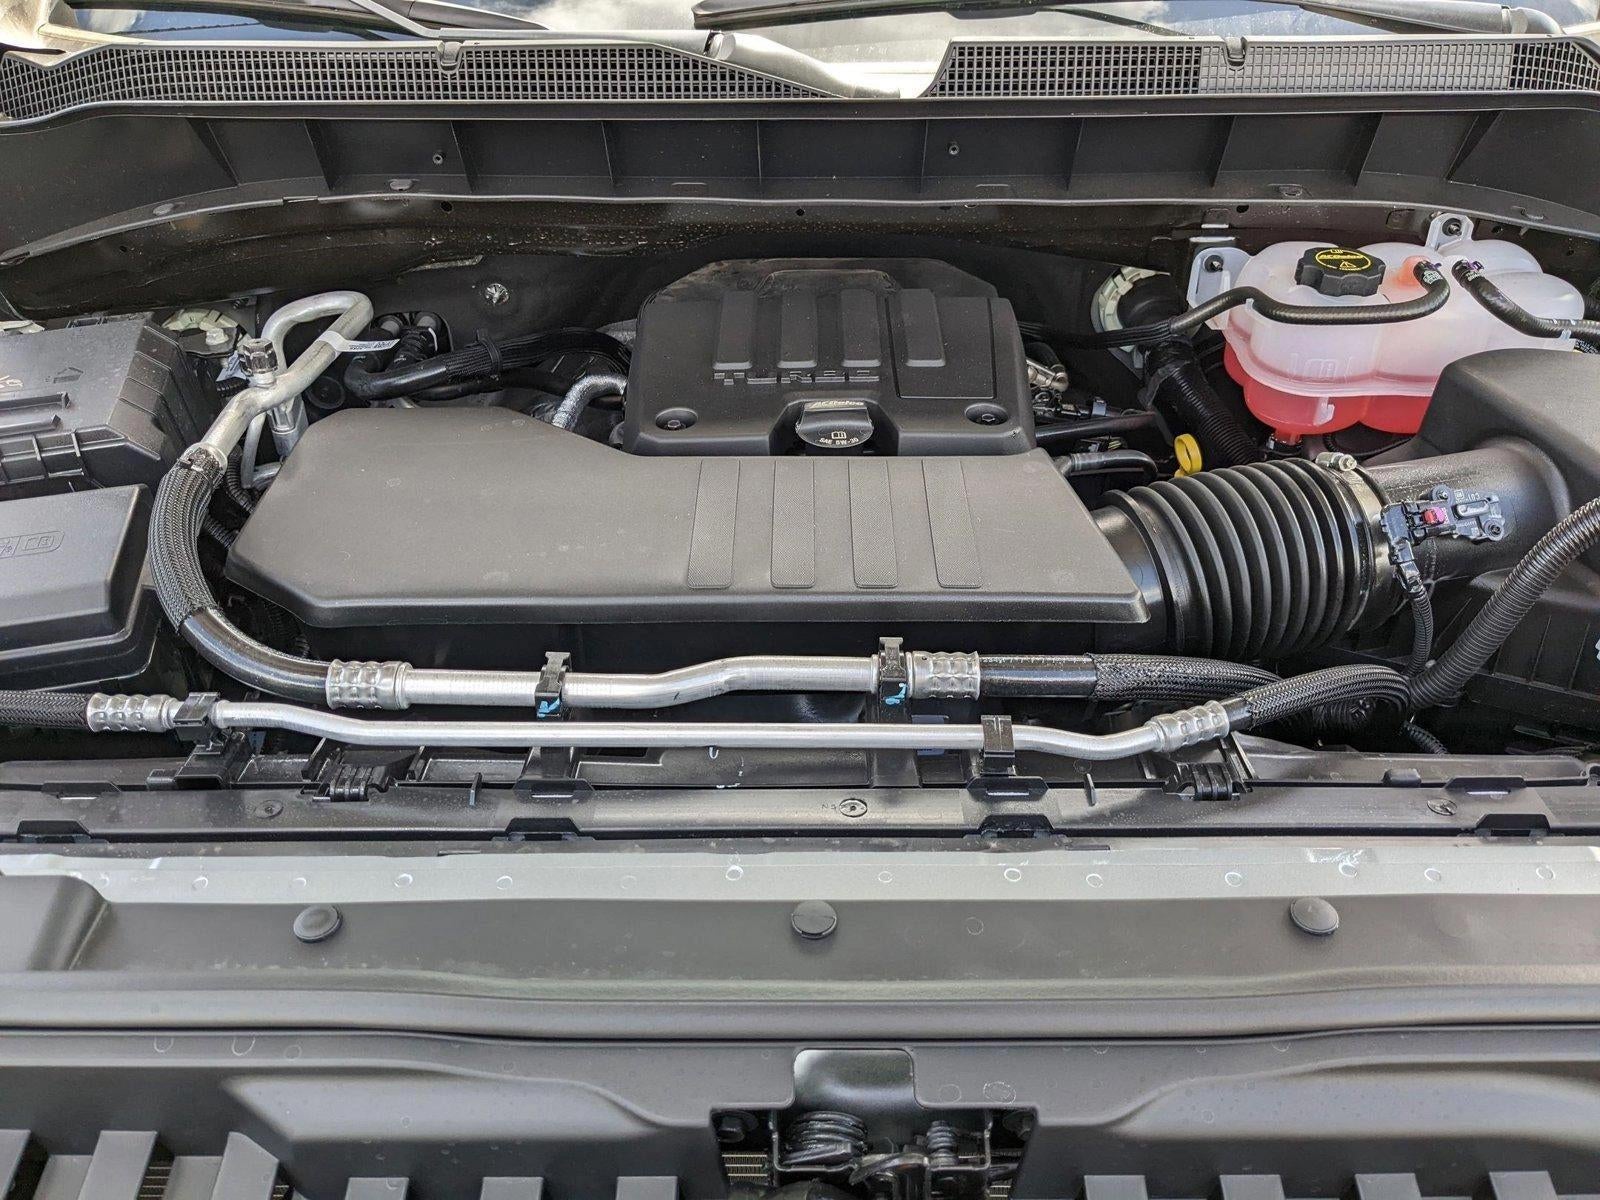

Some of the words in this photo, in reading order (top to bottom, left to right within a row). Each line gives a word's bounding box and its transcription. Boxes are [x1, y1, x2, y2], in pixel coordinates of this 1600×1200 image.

[713, 368, 880, 386] TURBO
[809, 400, 864, 409] ACDelco
[819, 437, 833, 445] SAE
